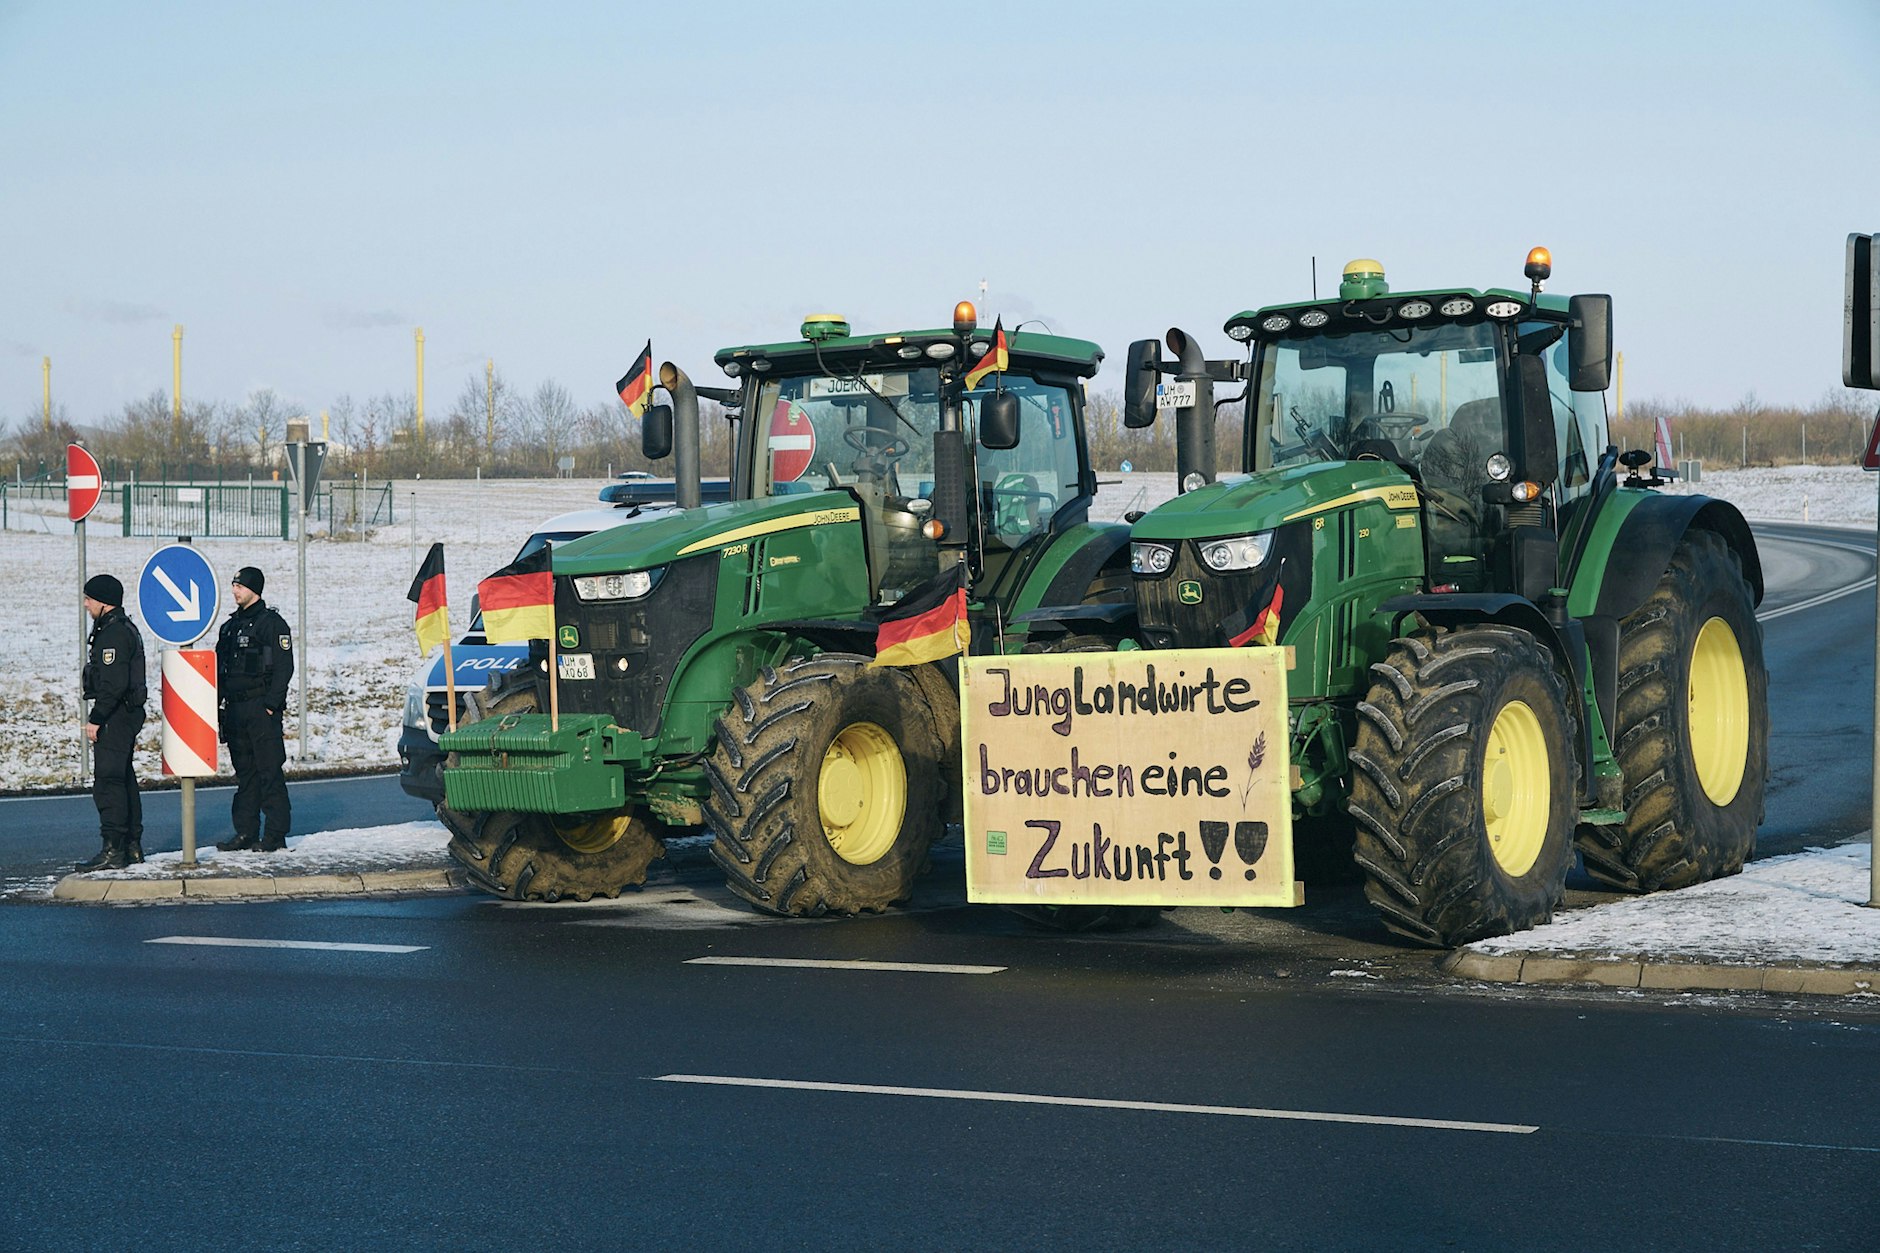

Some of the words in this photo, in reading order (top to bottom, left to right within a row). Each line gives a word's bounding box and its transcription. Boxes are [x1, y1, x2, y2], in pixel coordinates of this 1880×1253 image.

[1173, 395, 1191, 405] 777
[1400, 491, 1416, 501] DEERE
[814, 513, 830, 524] JOHN
[830, 511, 850, 521] DEERE
[979, 743, 1135, 798] brauchen
[1140, 751, 1231, 797] eine
